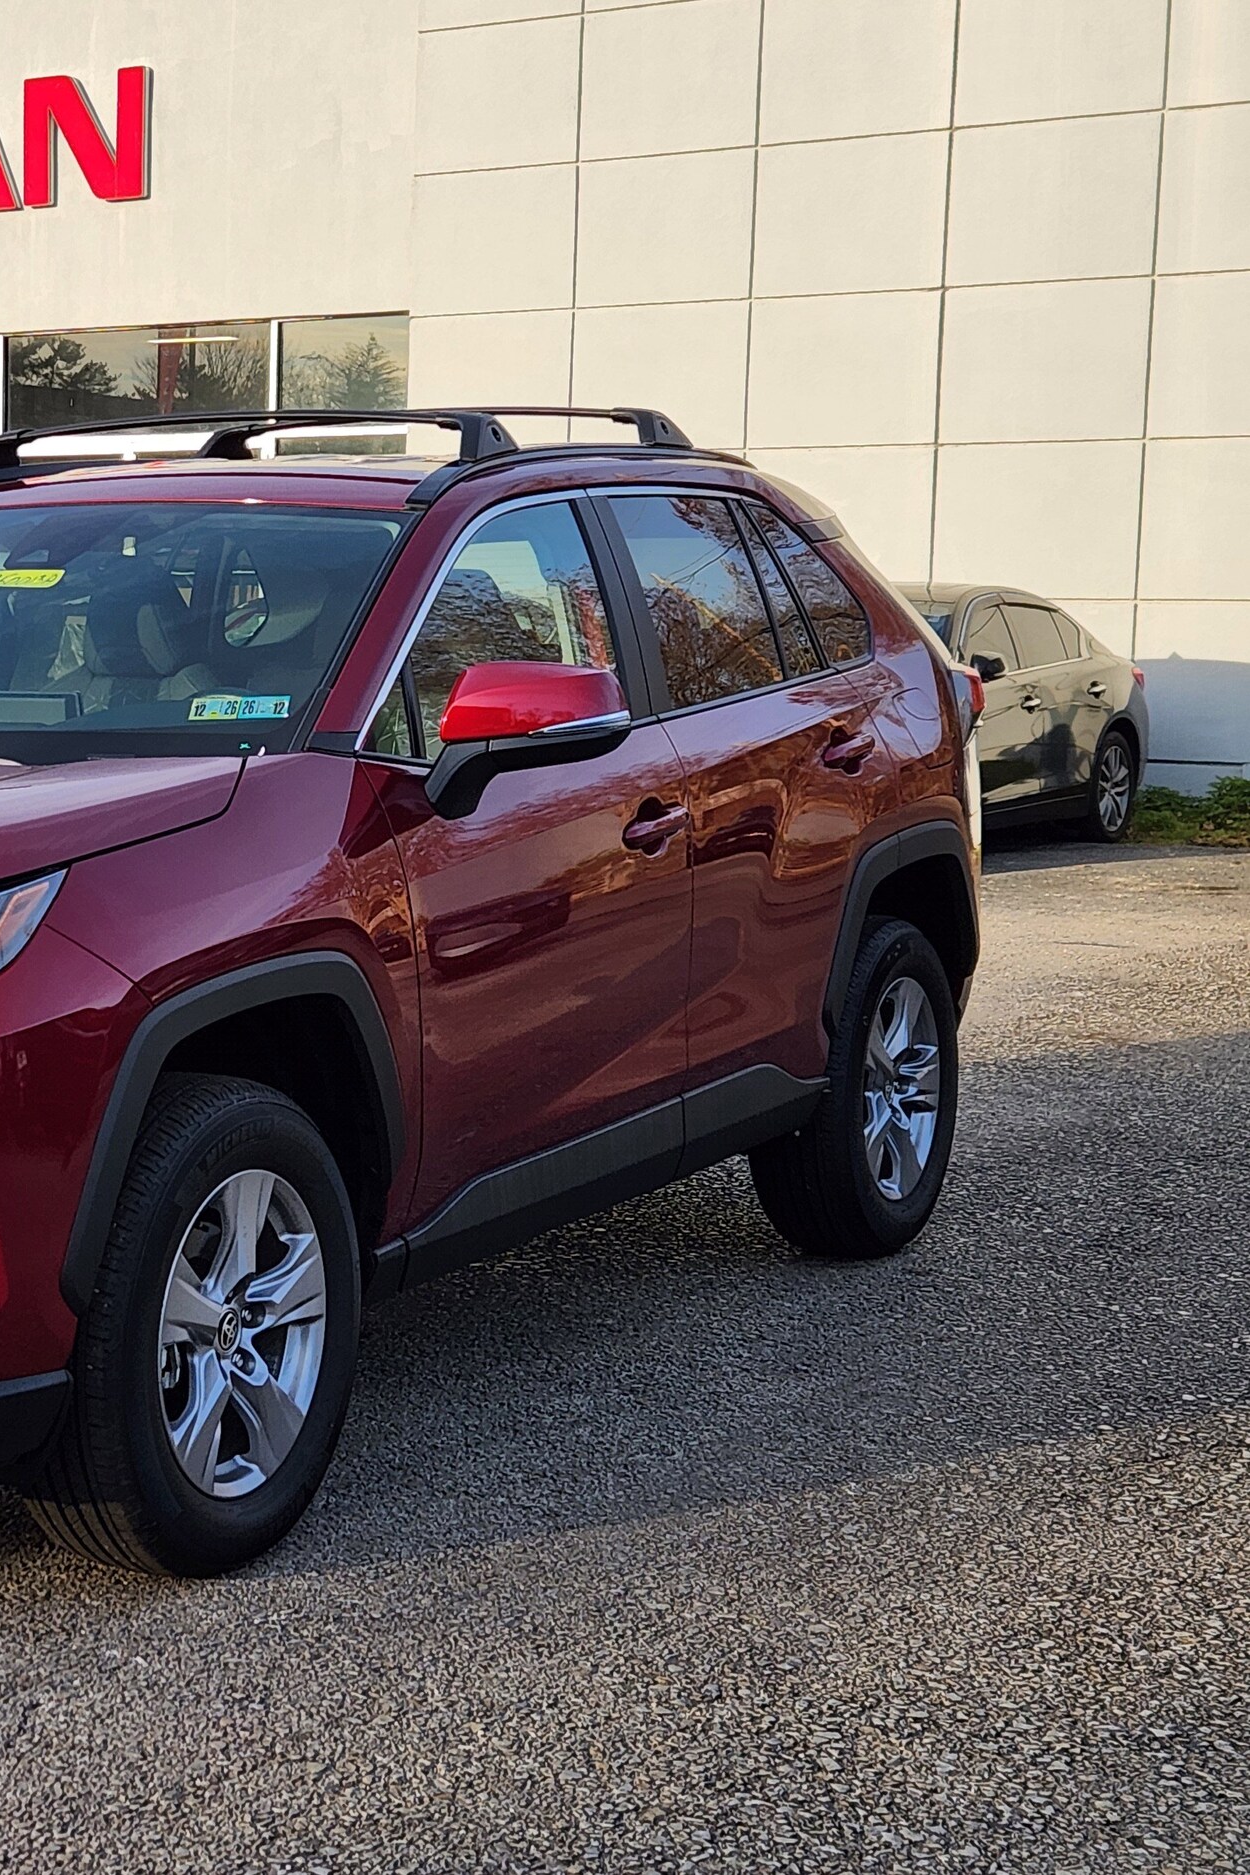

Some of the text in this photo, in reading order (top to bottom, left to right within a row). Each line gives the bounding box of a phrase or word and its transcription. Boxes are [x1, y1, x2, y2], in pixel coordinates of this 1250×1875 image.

[193, 704, 207, 717] 12
[224, 700, 239, 716] 26
[242, 700, 256, 715] 26
[272, 702, 285, 715] 12
